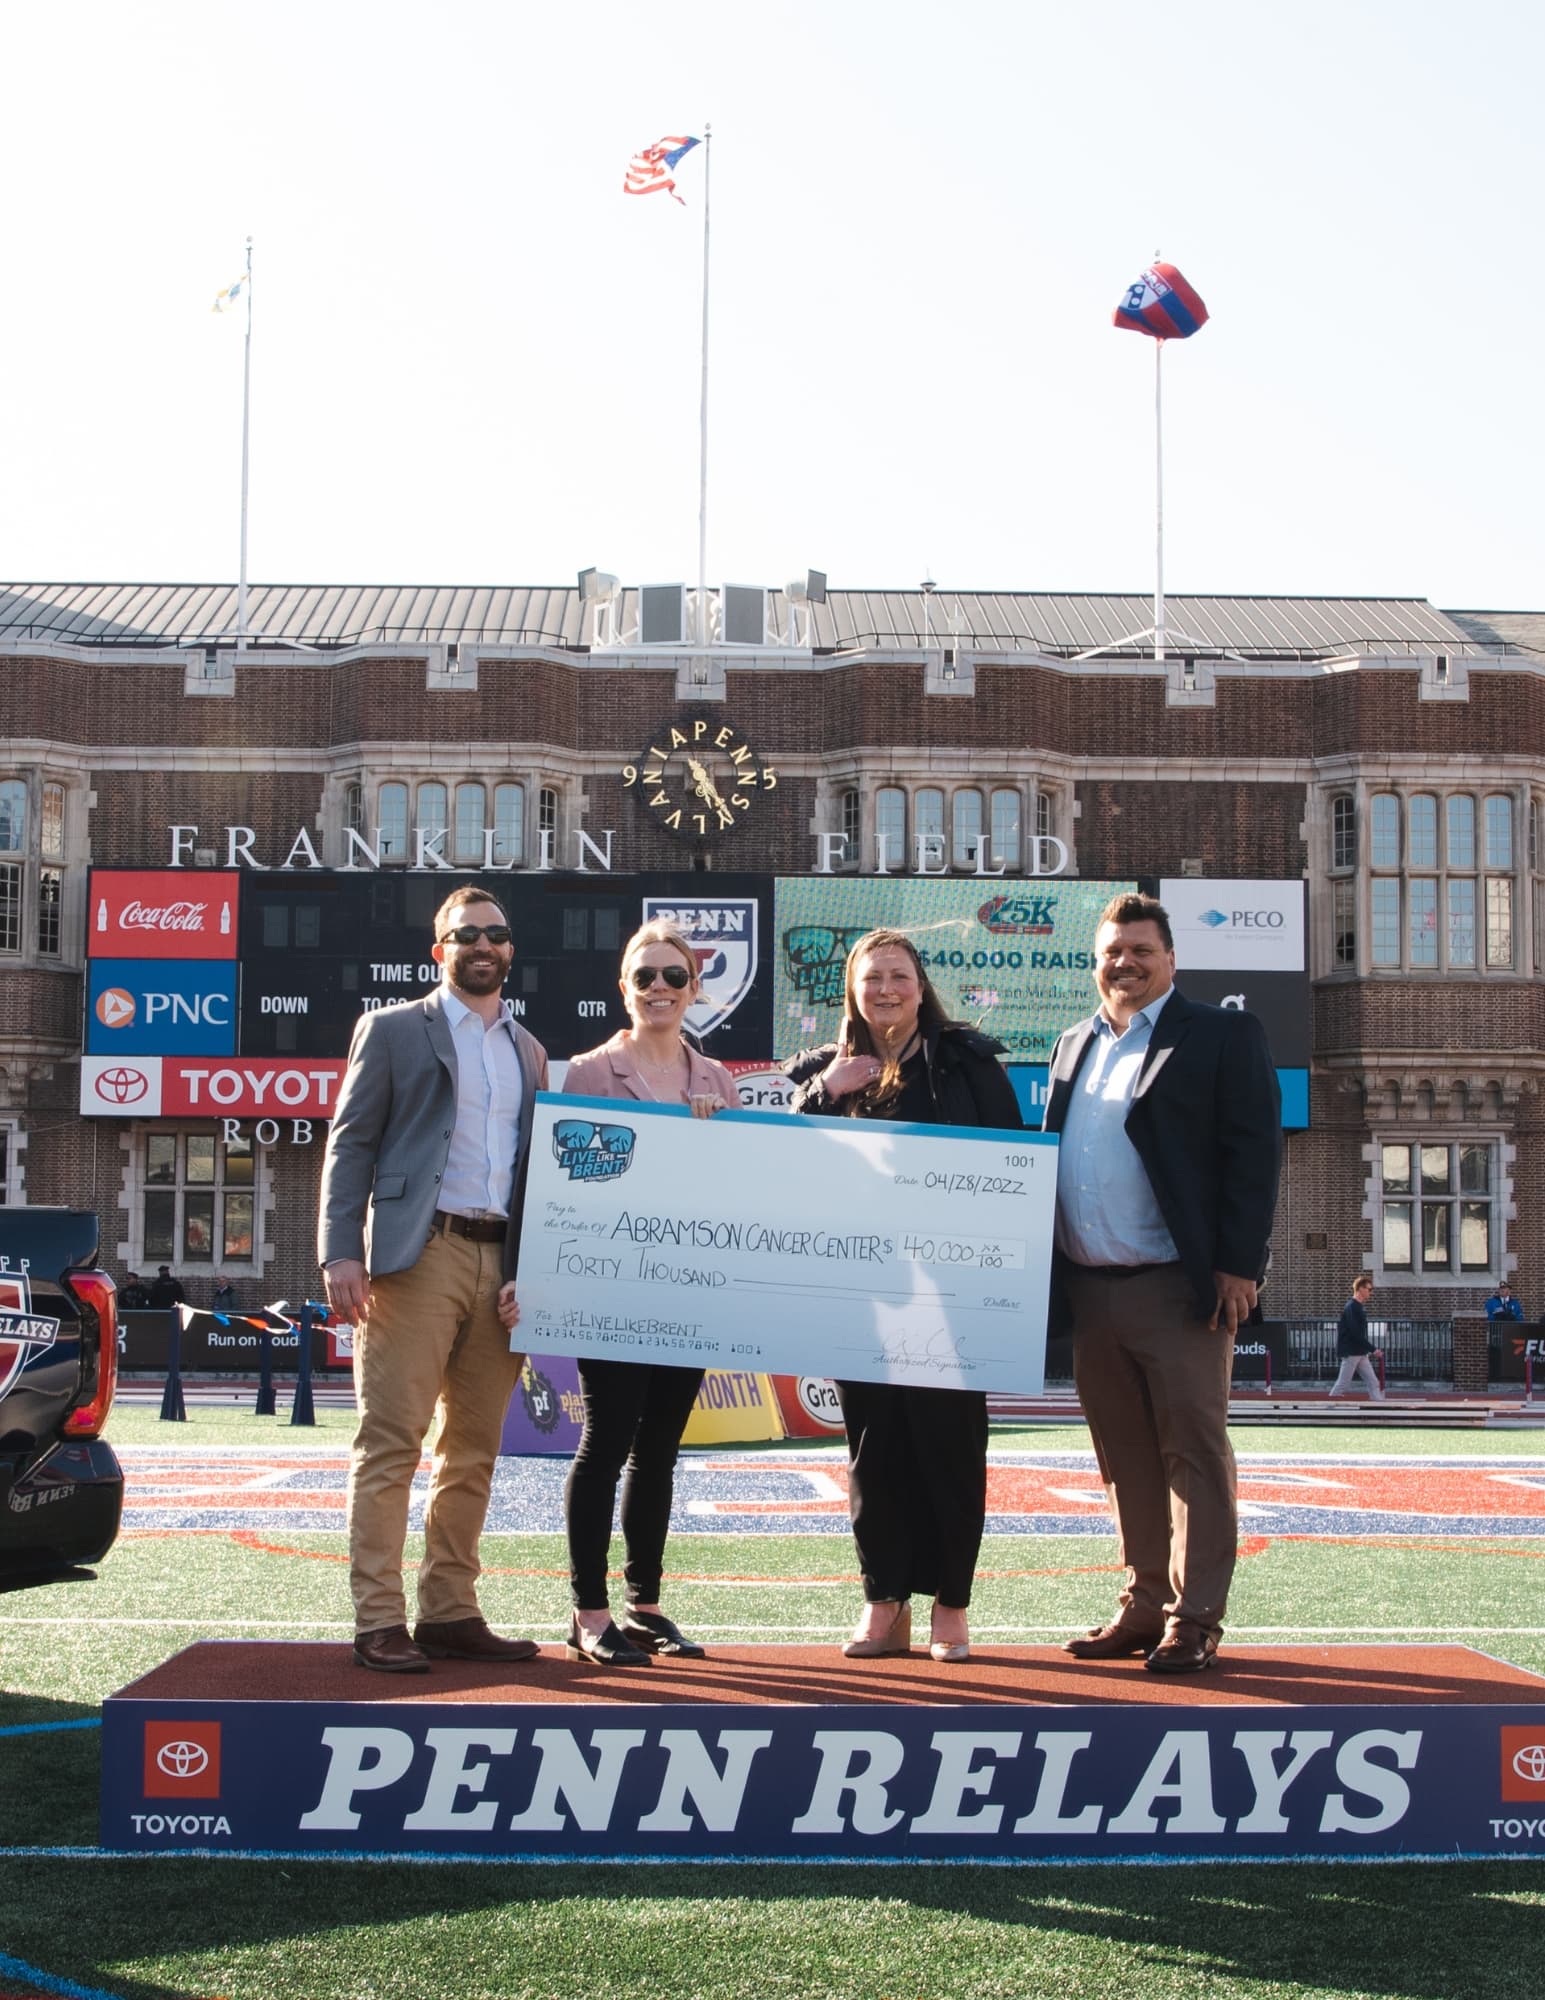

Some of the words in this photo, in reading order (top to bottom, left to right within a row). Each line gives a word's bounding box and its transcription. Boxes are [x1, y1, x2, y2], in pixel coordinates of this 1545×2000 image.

[167, 826, 617, 871] FRANKLIN
[817, 832, 1069, 876] FIELD
[118, 901, 208, 931] Coca-Cola
[655, 909, 747, 932] PENN
[1231, 910, 1284, 928] PECO
[920, 950, 1024, 971] $40,000
[370, 964, 412, 982] TIME
[418, 964, 444, 983] OU
[142, 993, 229, 1025] PNC
[260, 996, 308, 1014] DOWN
[577, 1000, 607, 1017] QTR
[732, 1063, 766, 1075] ALITY
[180, 1069, 342, 1105] TOYOT
[220, 1118, 335, 1145] ROB
[562, 1149, 598, 1166] LIVE
[572, 1159, 625, 1178] BRENT
[1004, 1155, 1035, 1168] 1001
[924, 1171, 1028, 1195] 04/28/2022
[610, 1210, 743, 1251] ABRAMSON
[745, 1223, 811, 1256] CANCER
[813, 1231, 884, 1264] CENTER
[903, 1234, 975, 1265] 40,000
[556, 1239, 623, 1279] FORTY
[632, 1245, 727, 1288] THOUSAND
[0, 1317, 54, 1339] LAYS
[560, 1308, 704, 1339] #LIVELIKEBRENT
[207, 1332, 236, 1347] Run
[238, 1335, 257, 1347] on
[1232, 1341, 1266, 1355] ouds
[559, 1390, 583, 1412] pla
[697, 1372, 763, 1410] MONTH
[532, 1390, 550, 1416] pf
[298, 1726, 773, 1832] PENN
[791, 1728, 1423, 1836] RELAYS
[131, 1815, 232, 1835] TOYOTA
